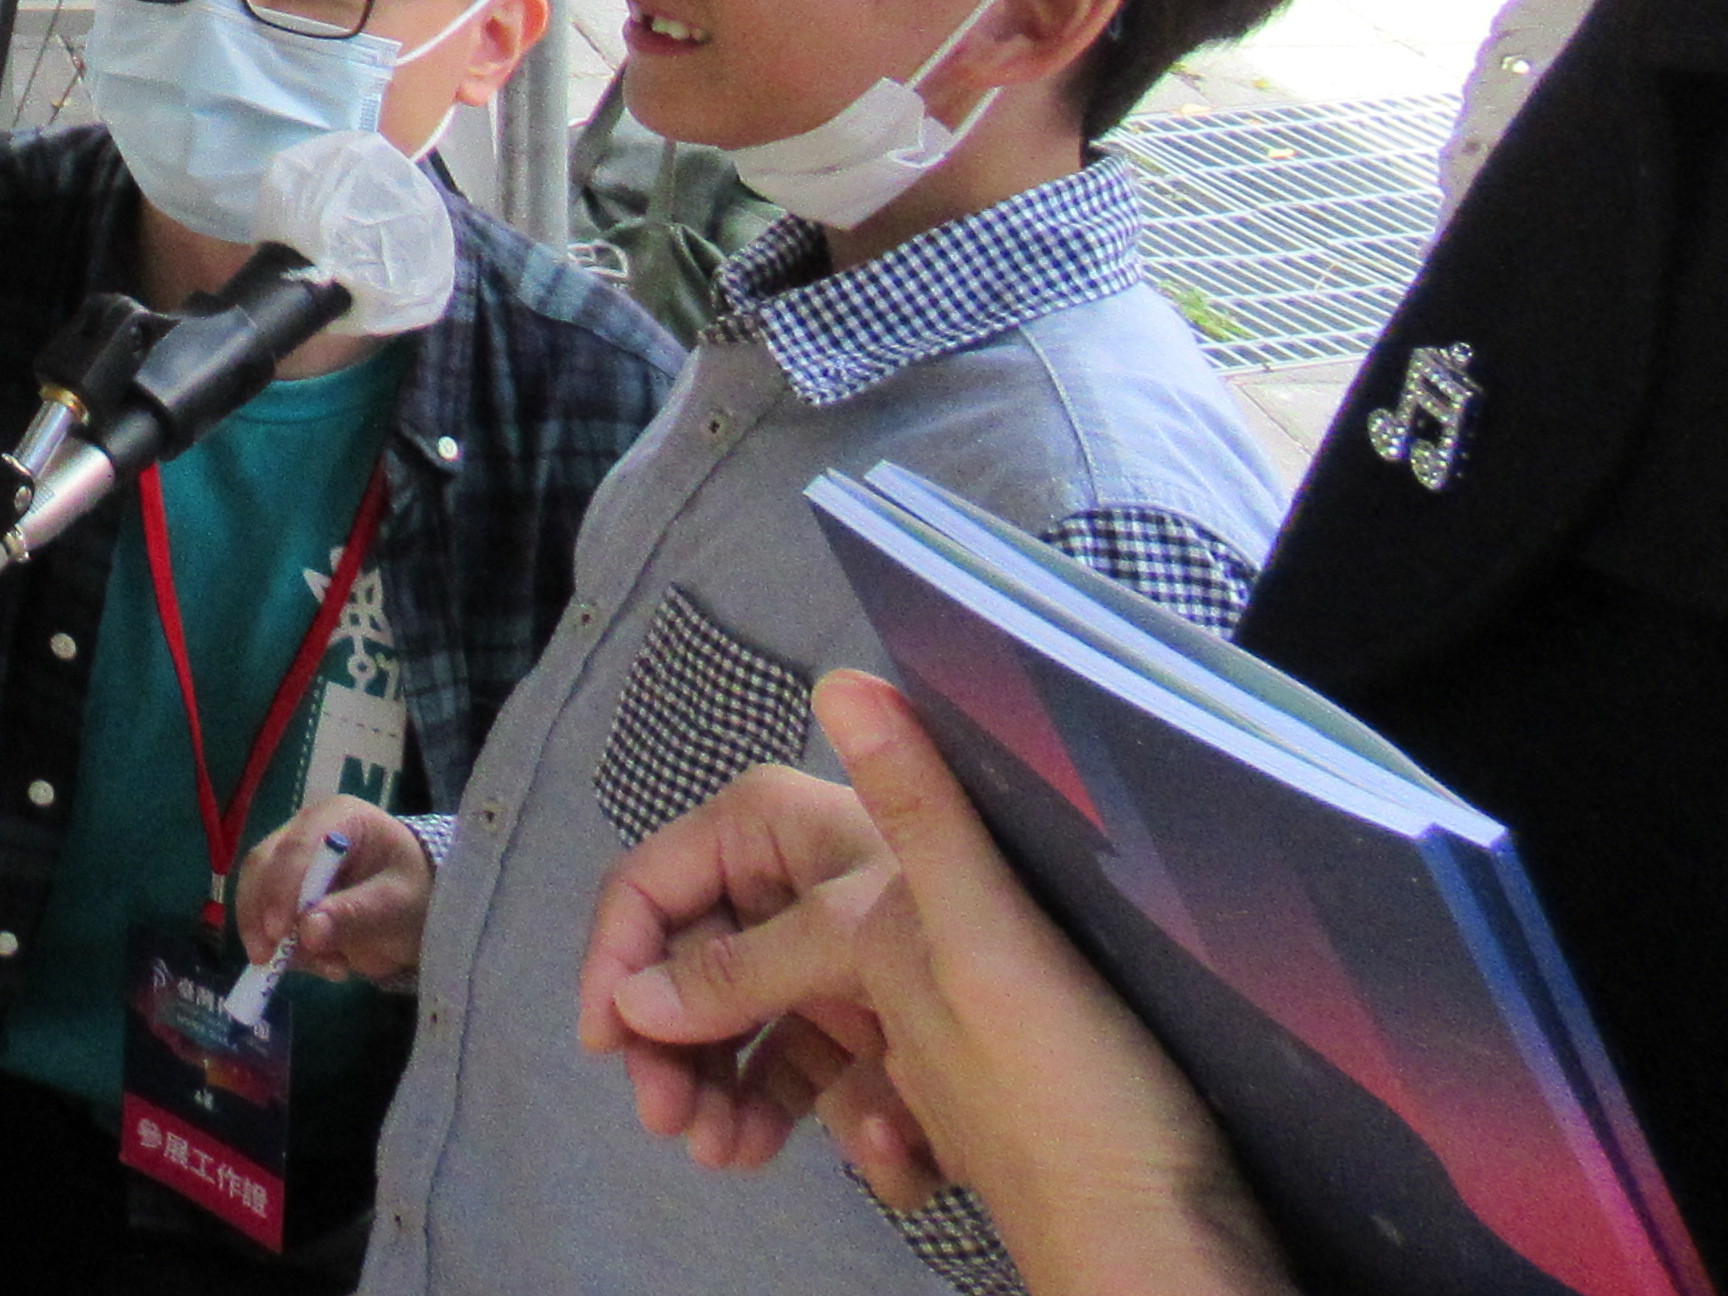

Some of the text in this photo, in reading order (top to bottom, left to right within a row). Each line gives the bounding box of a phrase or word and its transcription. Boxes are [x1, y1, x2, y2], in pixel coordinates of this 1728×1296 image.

[137, 1117, 269, 1220] 參展工作證
